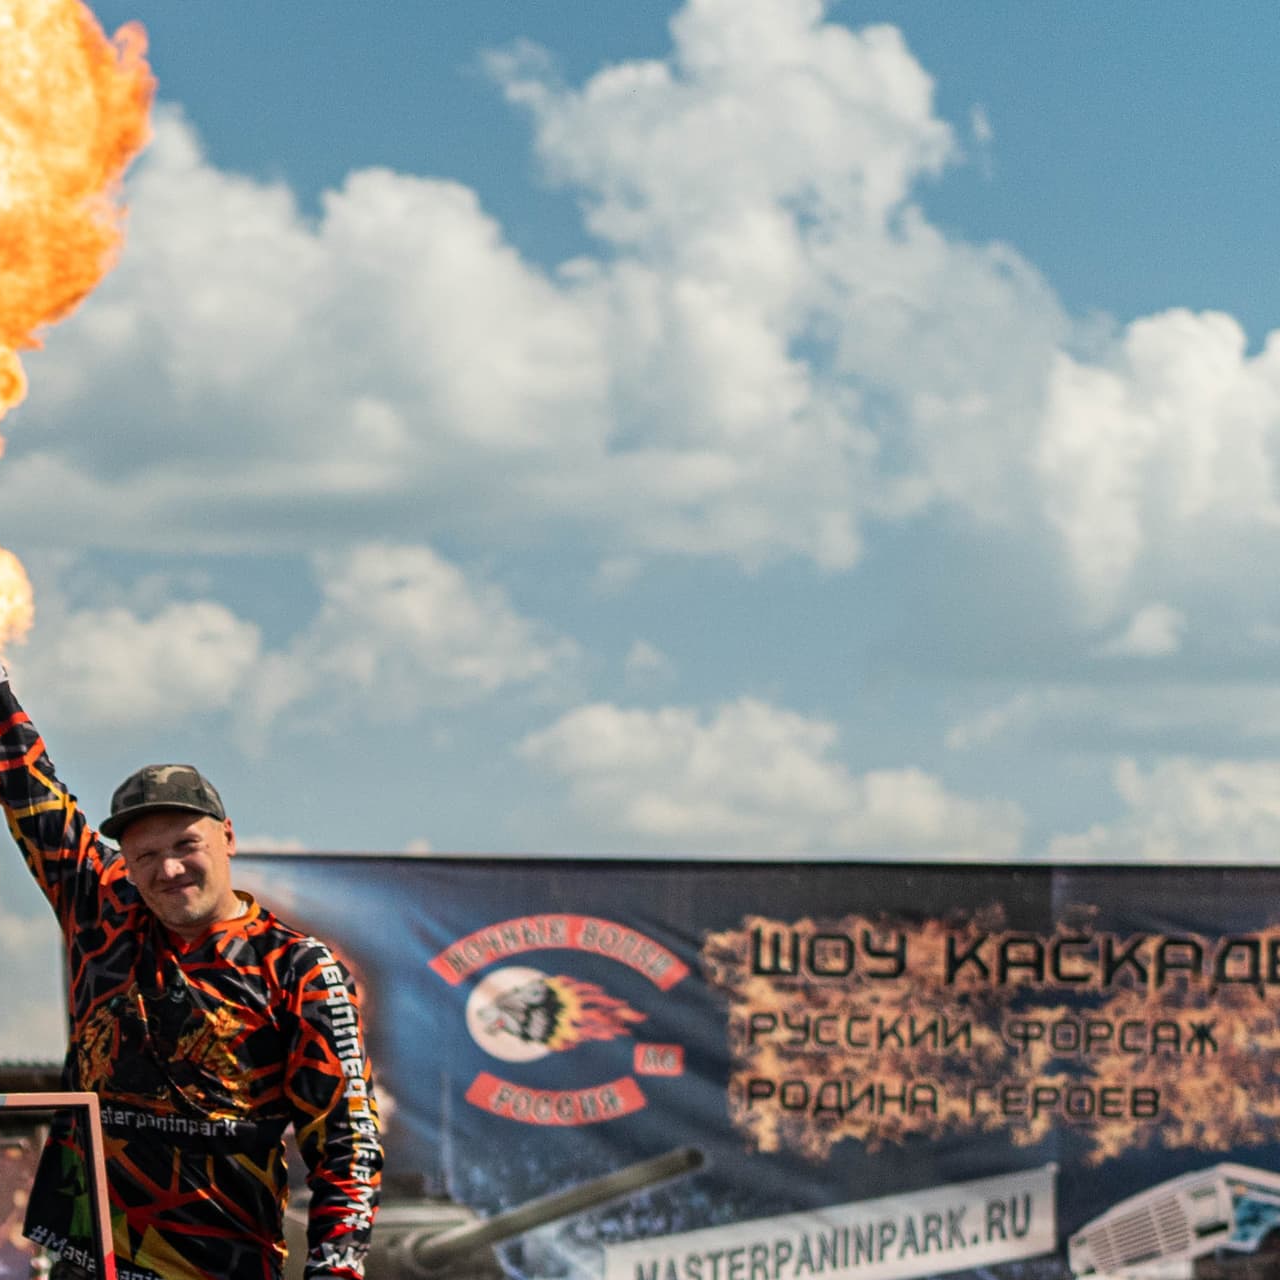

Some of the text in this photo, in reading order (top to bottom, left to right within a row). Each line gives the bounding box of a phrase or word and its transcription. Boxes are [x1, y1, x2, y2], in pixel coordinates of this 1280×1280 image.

[752, 927, 906, 978] ШОУ
[1008, 1019, 1218, 1054] ФОРСАЖ
[492, 1088, 622, 1121] РОССИЯ
[747, 1078, 1160, 1119] РОДИНА ГЕРОЕВ
